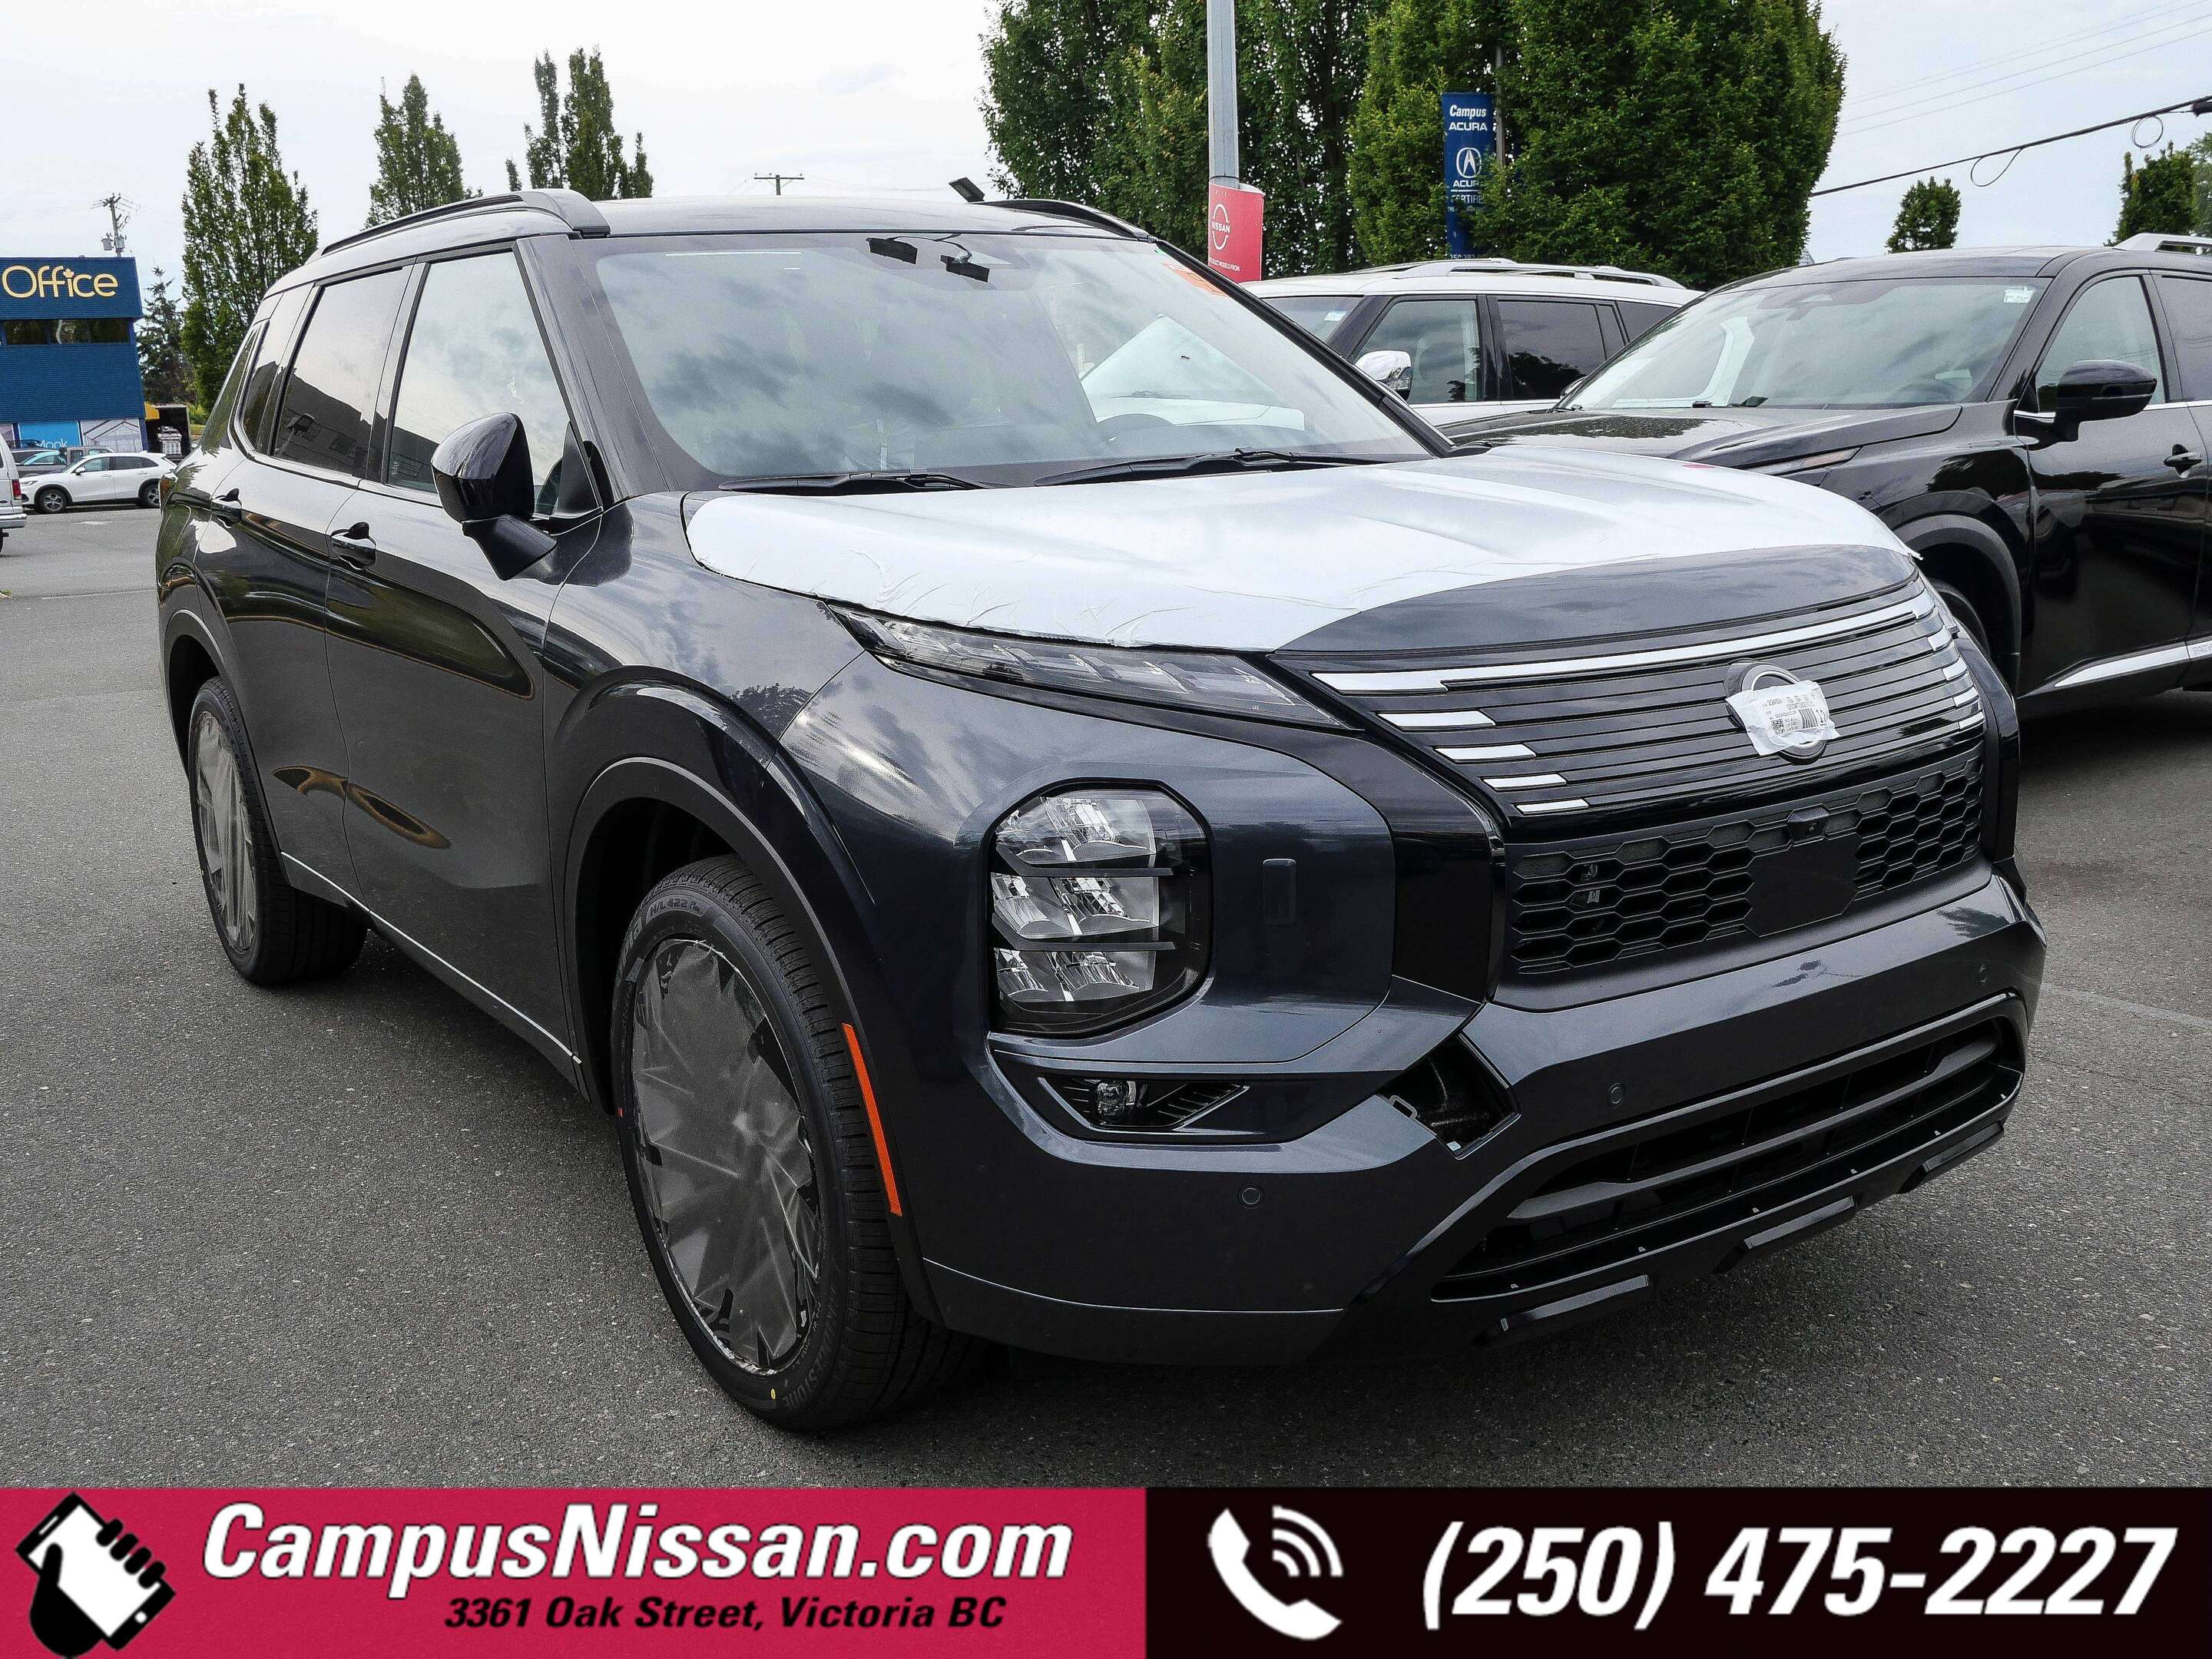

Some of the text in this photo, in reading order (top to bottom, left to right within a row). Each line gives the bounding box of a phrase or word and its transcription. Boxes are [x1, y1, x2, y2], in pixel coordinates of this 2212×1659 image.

[1449, 104, 1487, 120] Campus
[1449, 122, 1488, 131] ACURA
[1453, 180, 1481, 188] ACUR
[1451, 194, 1484, 204] CRTIFIE
[1211, 220, 1230, 233] NISSAN
[2, 265, 118, 298] Office
